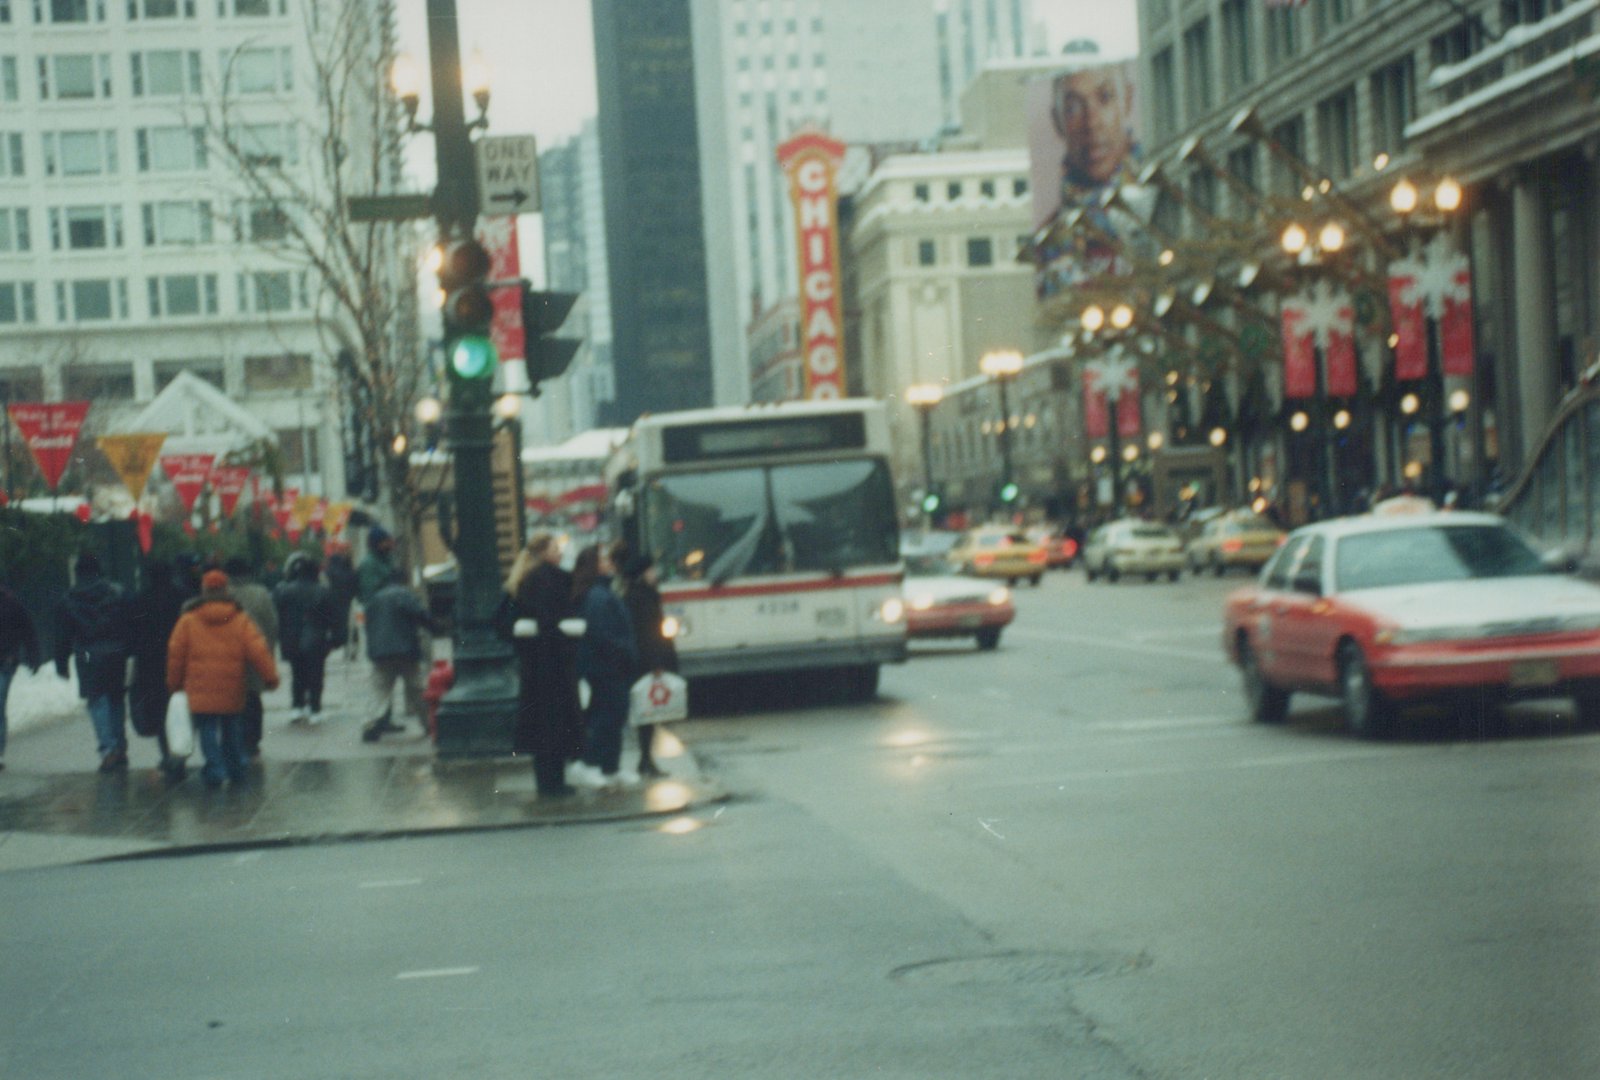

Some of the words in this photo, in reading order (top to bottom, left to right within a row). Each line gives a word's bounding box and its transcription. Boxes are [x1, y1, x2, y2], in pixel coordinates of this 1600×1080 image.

[485, 141, 528, 160] ONE
[487, 162, 531, 182] WAY
[798, 159, 839, 400] CHICAGO
